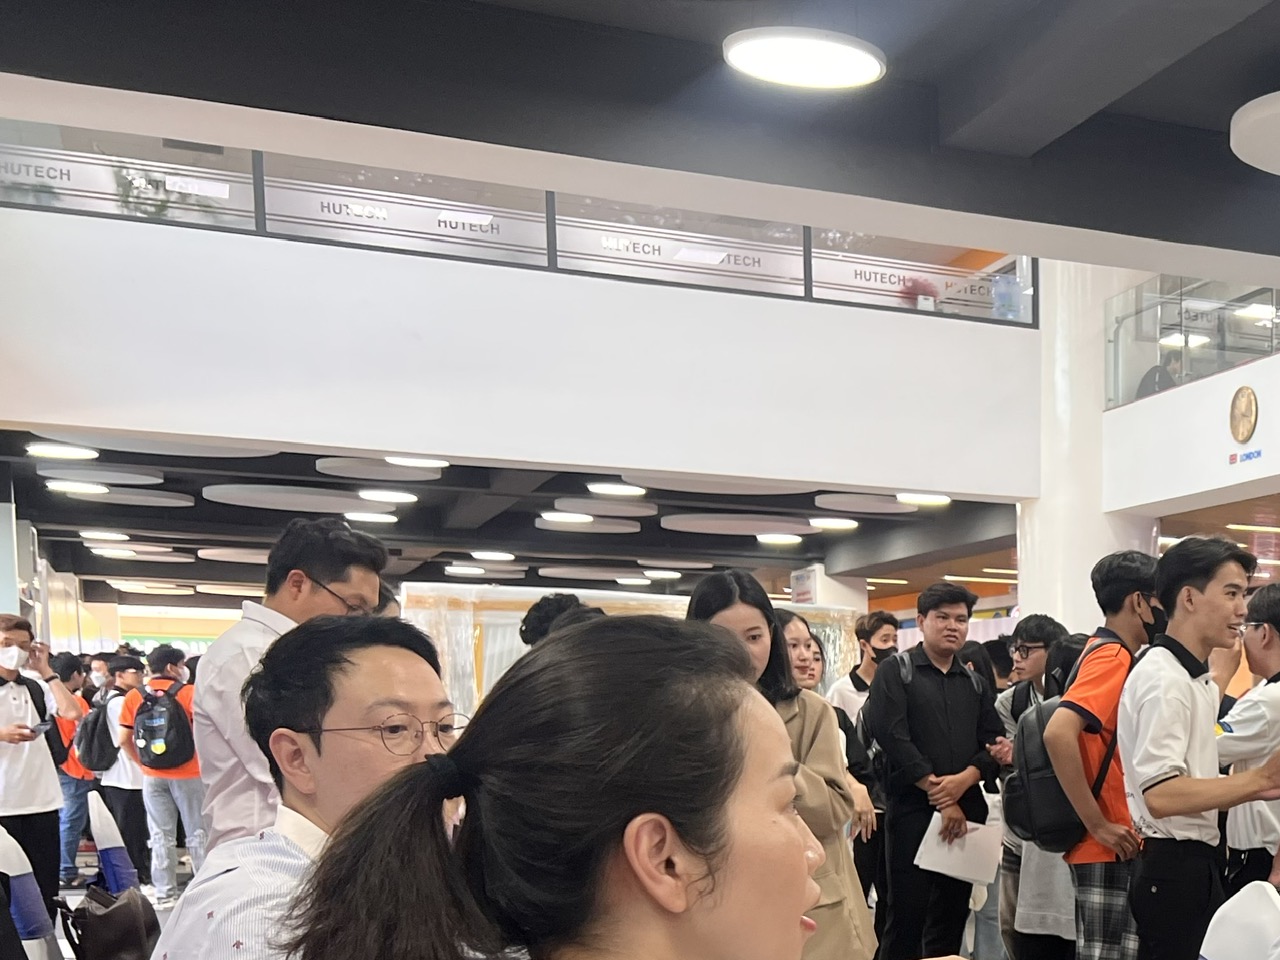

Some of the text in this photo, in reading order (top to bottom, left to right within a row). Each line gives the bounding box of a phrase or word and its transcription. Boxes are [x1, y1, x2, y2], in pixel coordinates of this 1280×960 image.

[719, 253, 761, 268] TECH
[854, 269, 906, 287] HUTECH
[1239, 450, 1262, 462] LONDON
